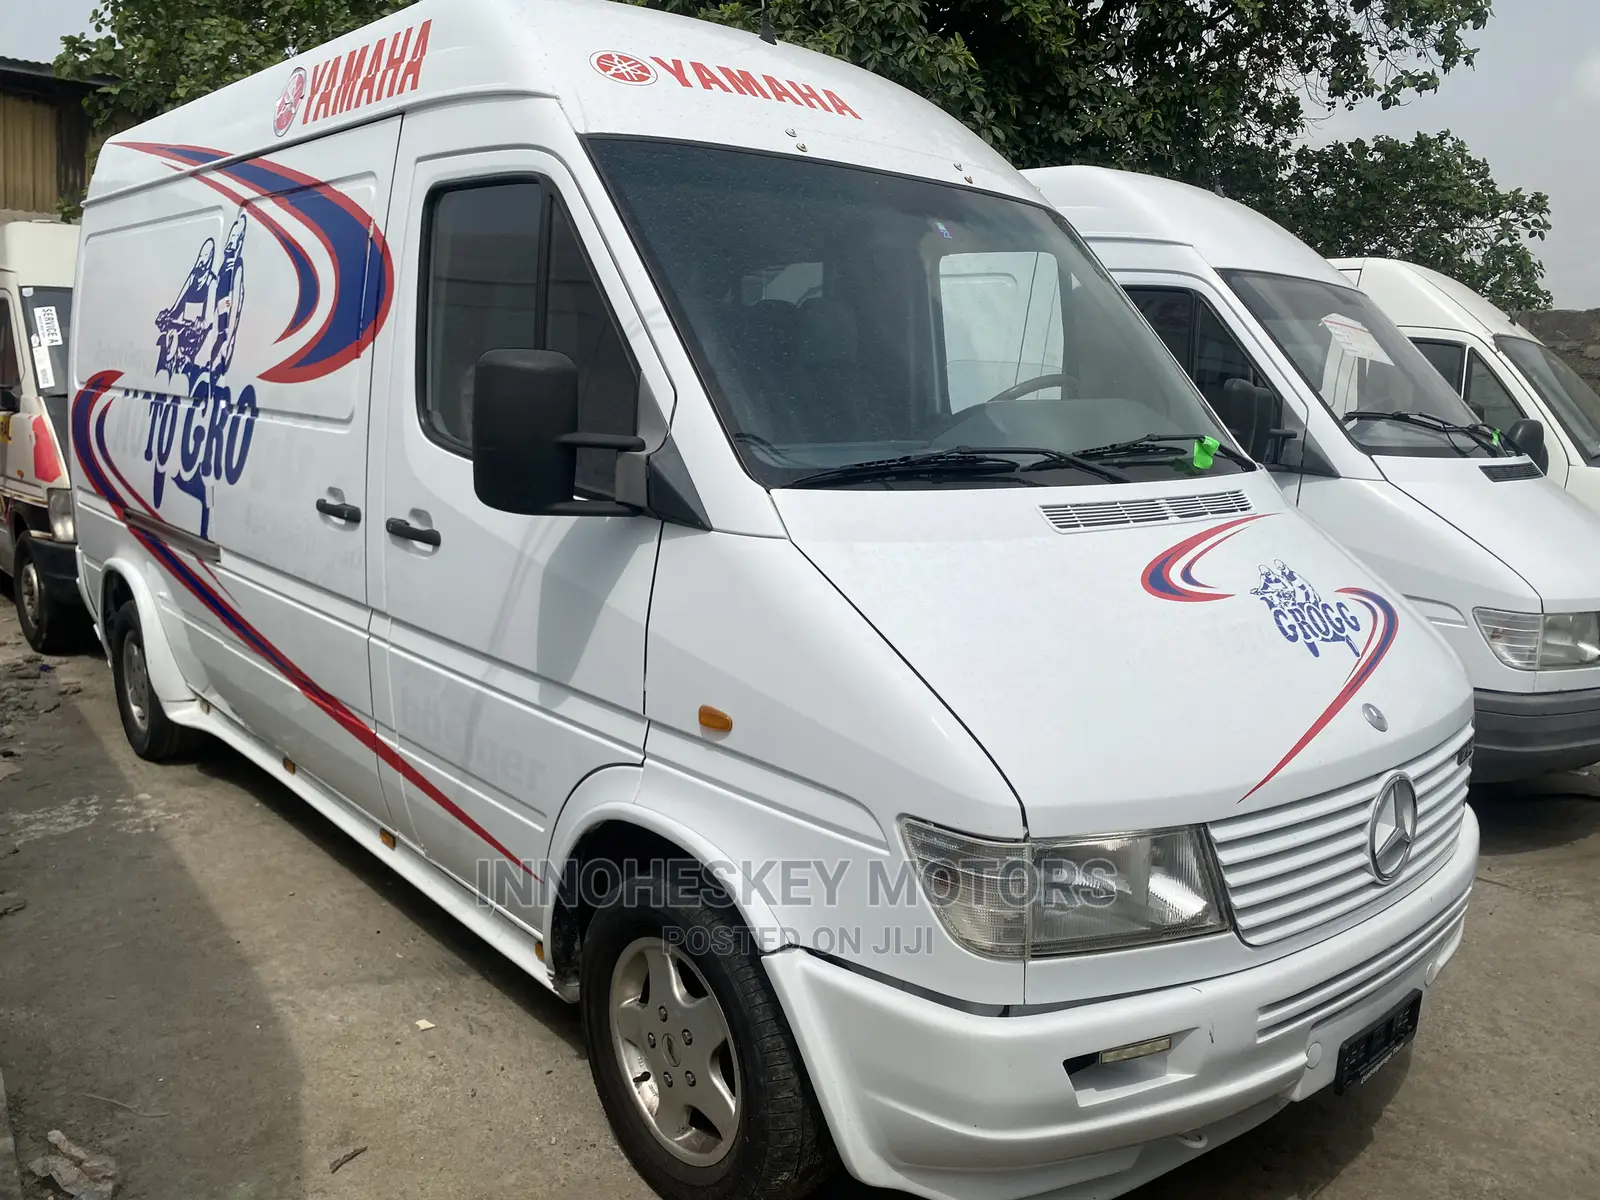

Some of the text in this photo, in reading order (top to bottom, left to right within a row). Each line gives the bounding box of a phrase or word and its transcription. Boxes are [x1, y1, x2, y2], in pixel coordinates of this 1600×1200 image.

[302, 19, 432, 125] YAMAHA
[649, 56, 863, 120] YAMAHA
[42, 308, 58, 337] SERVICE
